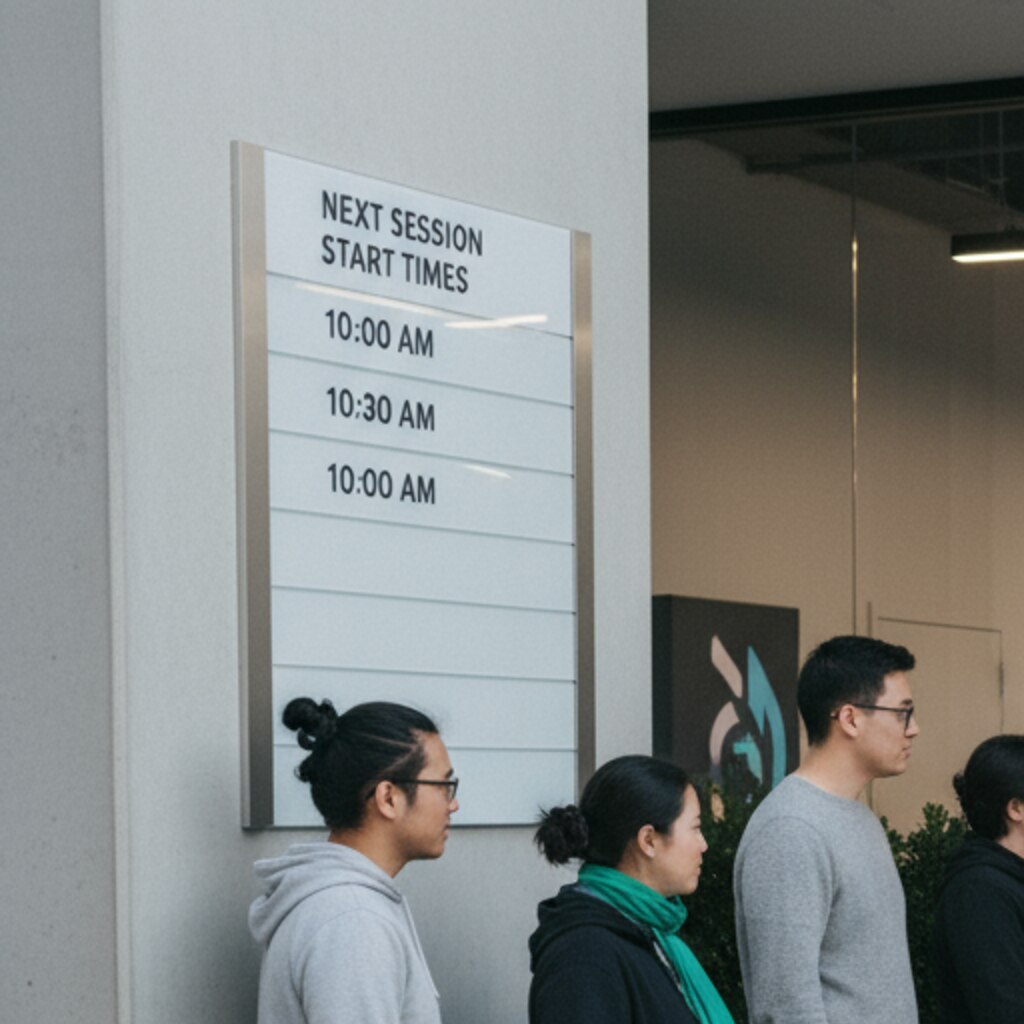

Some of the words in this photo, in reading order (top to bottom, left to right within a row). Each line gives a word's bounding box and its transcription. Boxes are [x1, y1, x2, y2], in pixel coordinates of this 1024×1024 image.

[322, 190, 384, 232] NEXT
[391, 207, 483, 256] SESSION
[322, 234, 395, 277] START
[401, 252, 469, 294] TIMES
[325, 309, 392, 350] 10:00
[397, 324, 434, 358] AM
[398, 399, 435, 431] AM
[327, 463, 394, 499] 10:00
[399, 473, 435, 505] AM
